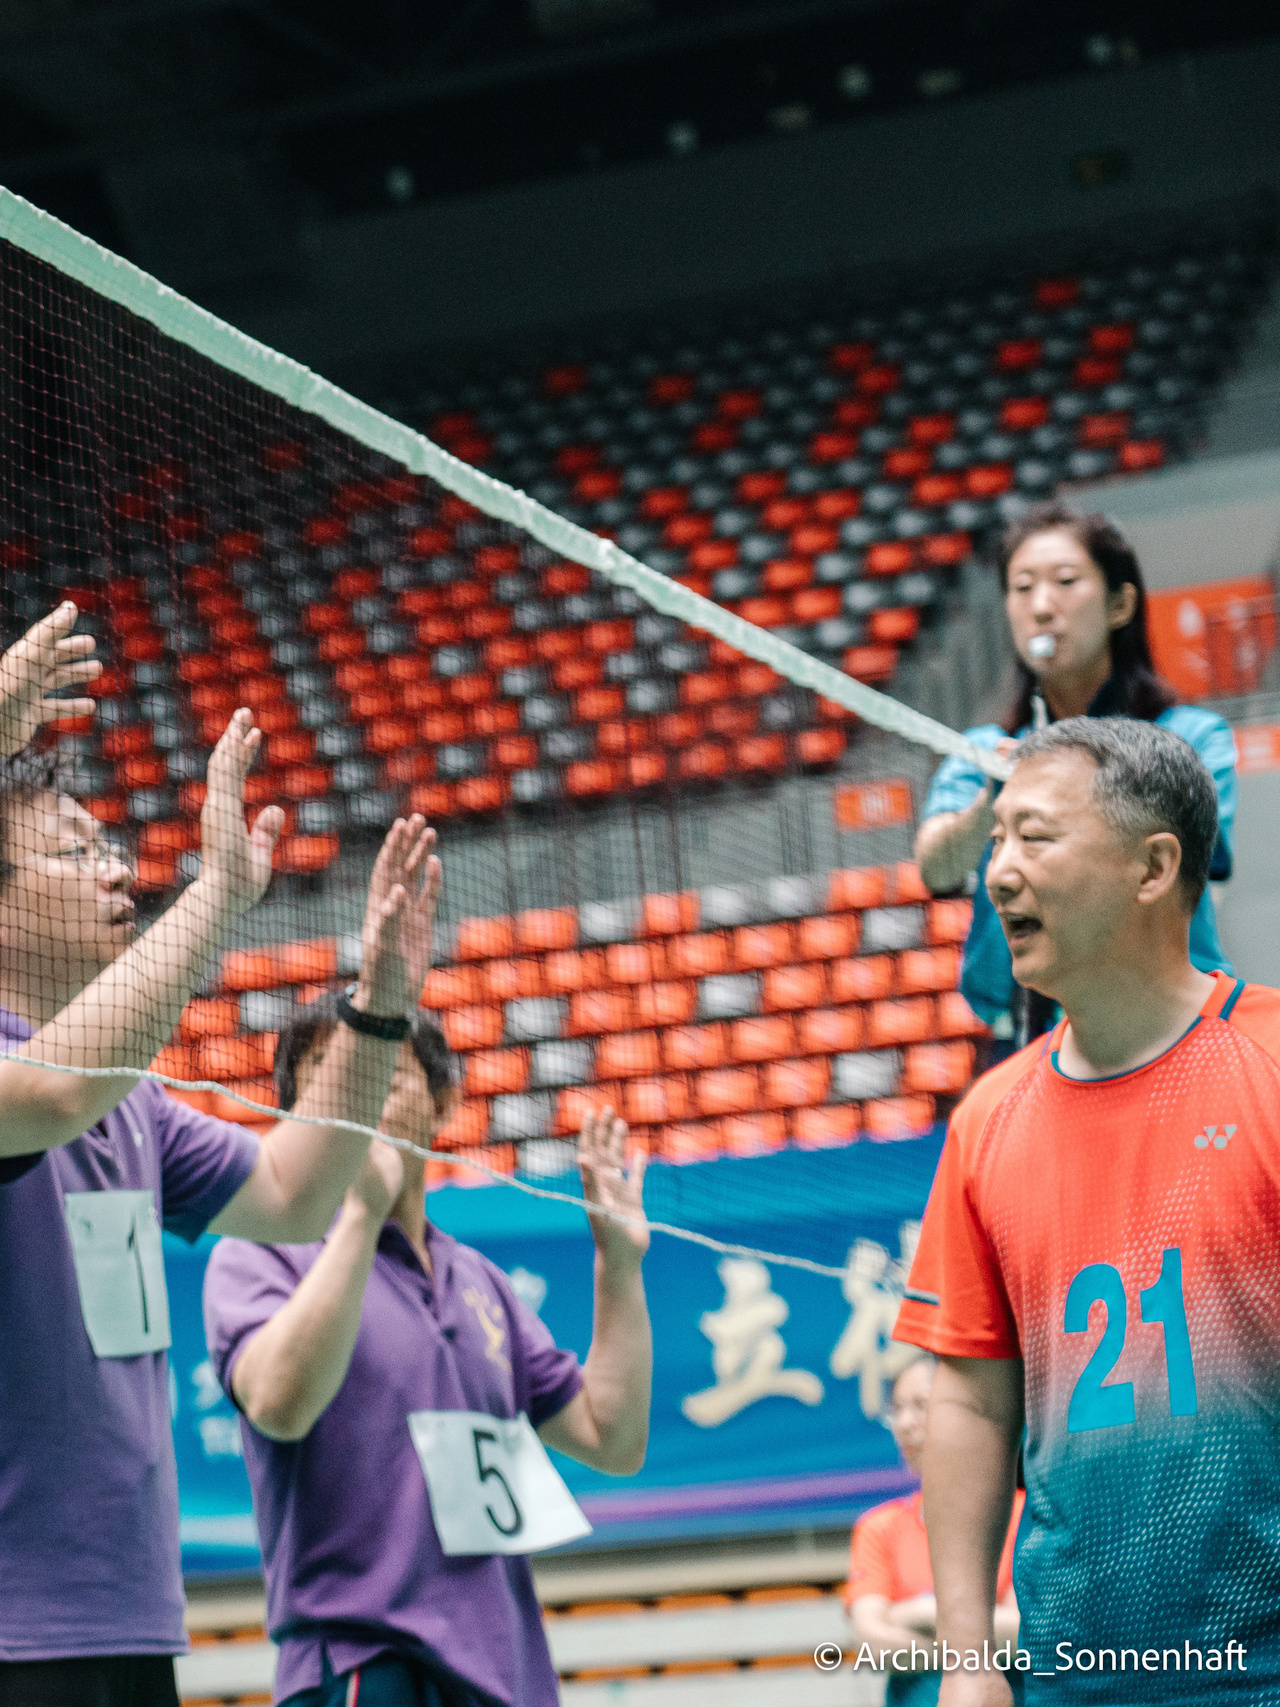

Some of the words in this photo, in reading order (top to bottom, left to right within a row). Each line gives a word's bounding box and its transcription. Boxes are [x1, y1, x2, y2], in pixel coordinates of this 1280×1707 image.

[127, 1209, 150, 1335] 1
[1063, 1246, 1199, 1434] 21
[471, 1426, 524, 1539] 5
